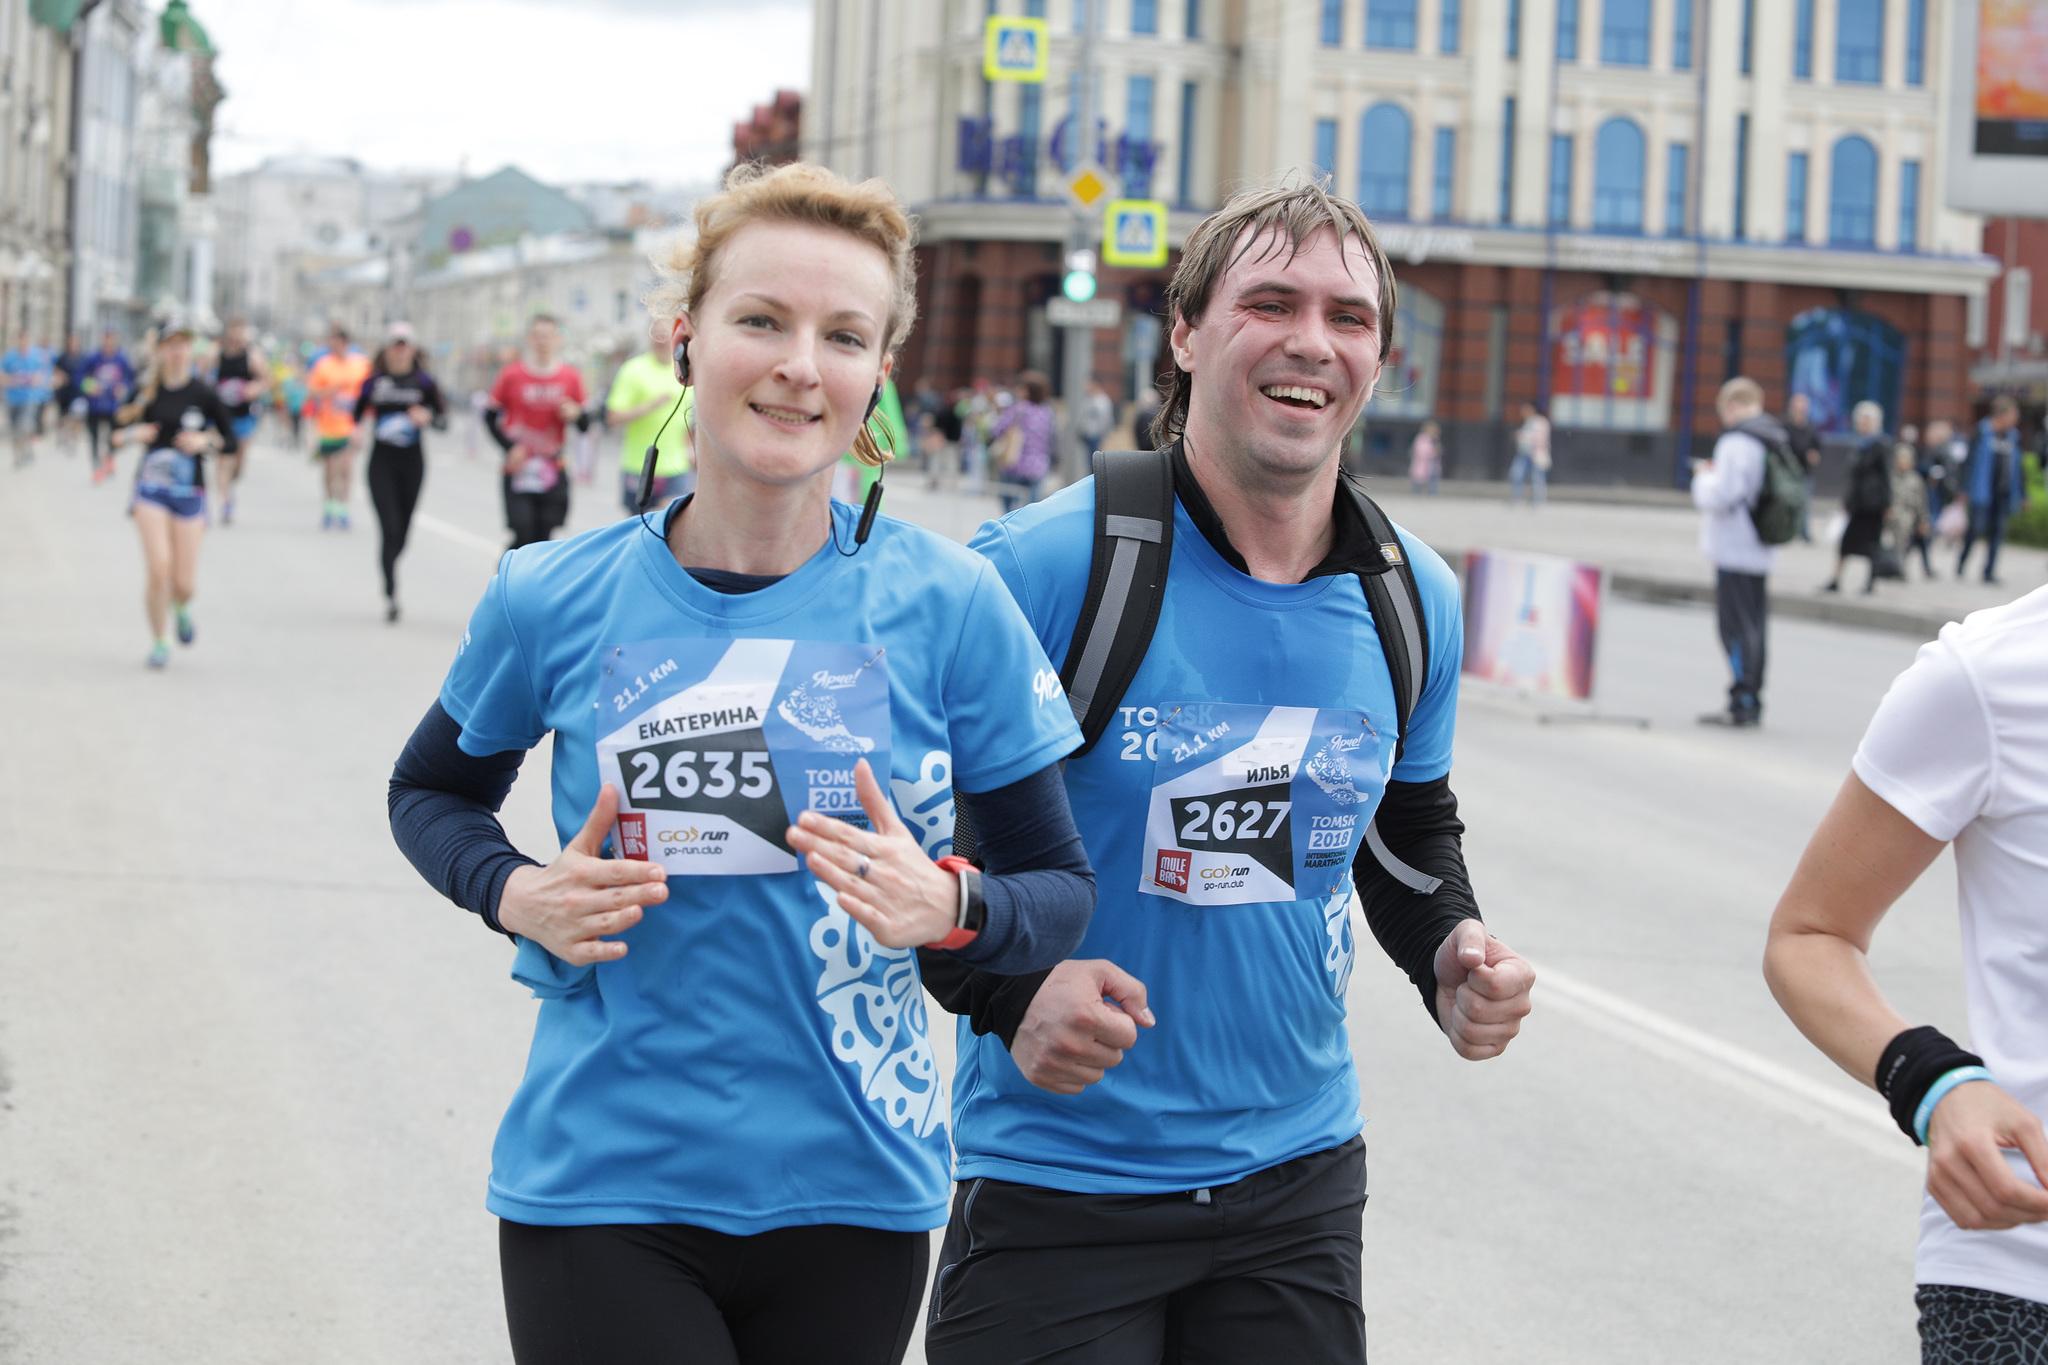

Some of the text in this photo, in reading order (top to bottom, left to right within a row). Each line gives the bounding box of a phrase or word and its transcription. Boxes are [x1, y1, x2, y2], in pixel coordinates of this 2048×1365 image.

[613, 673, 651, 713] 21,1
[638, 705, 759, 741] ЕКАТЕРИНА
[1171, 734, 1208, 764] 21,1
[629, 750, 774, 800] 2635
[1246, 764, 1290, 784] ИЛЬЯ
[1179, 800, 1293, 842] 2627
[1311, 814, 1359, 829] TOMSK
[657, 830, 730, 843] GO run
[1312, 830, 1350, 848] 2018
[663, 845, 723, 857] go-run.club
[1160, 856, 1187, 873] MULE
[1303, 855, 1347, 869] MARATHON
[1159, 869, 1177, 884] BAR
[1200, 867, 1250, 879] GO run
[1203, 880, 1245, 891] go-run.club
